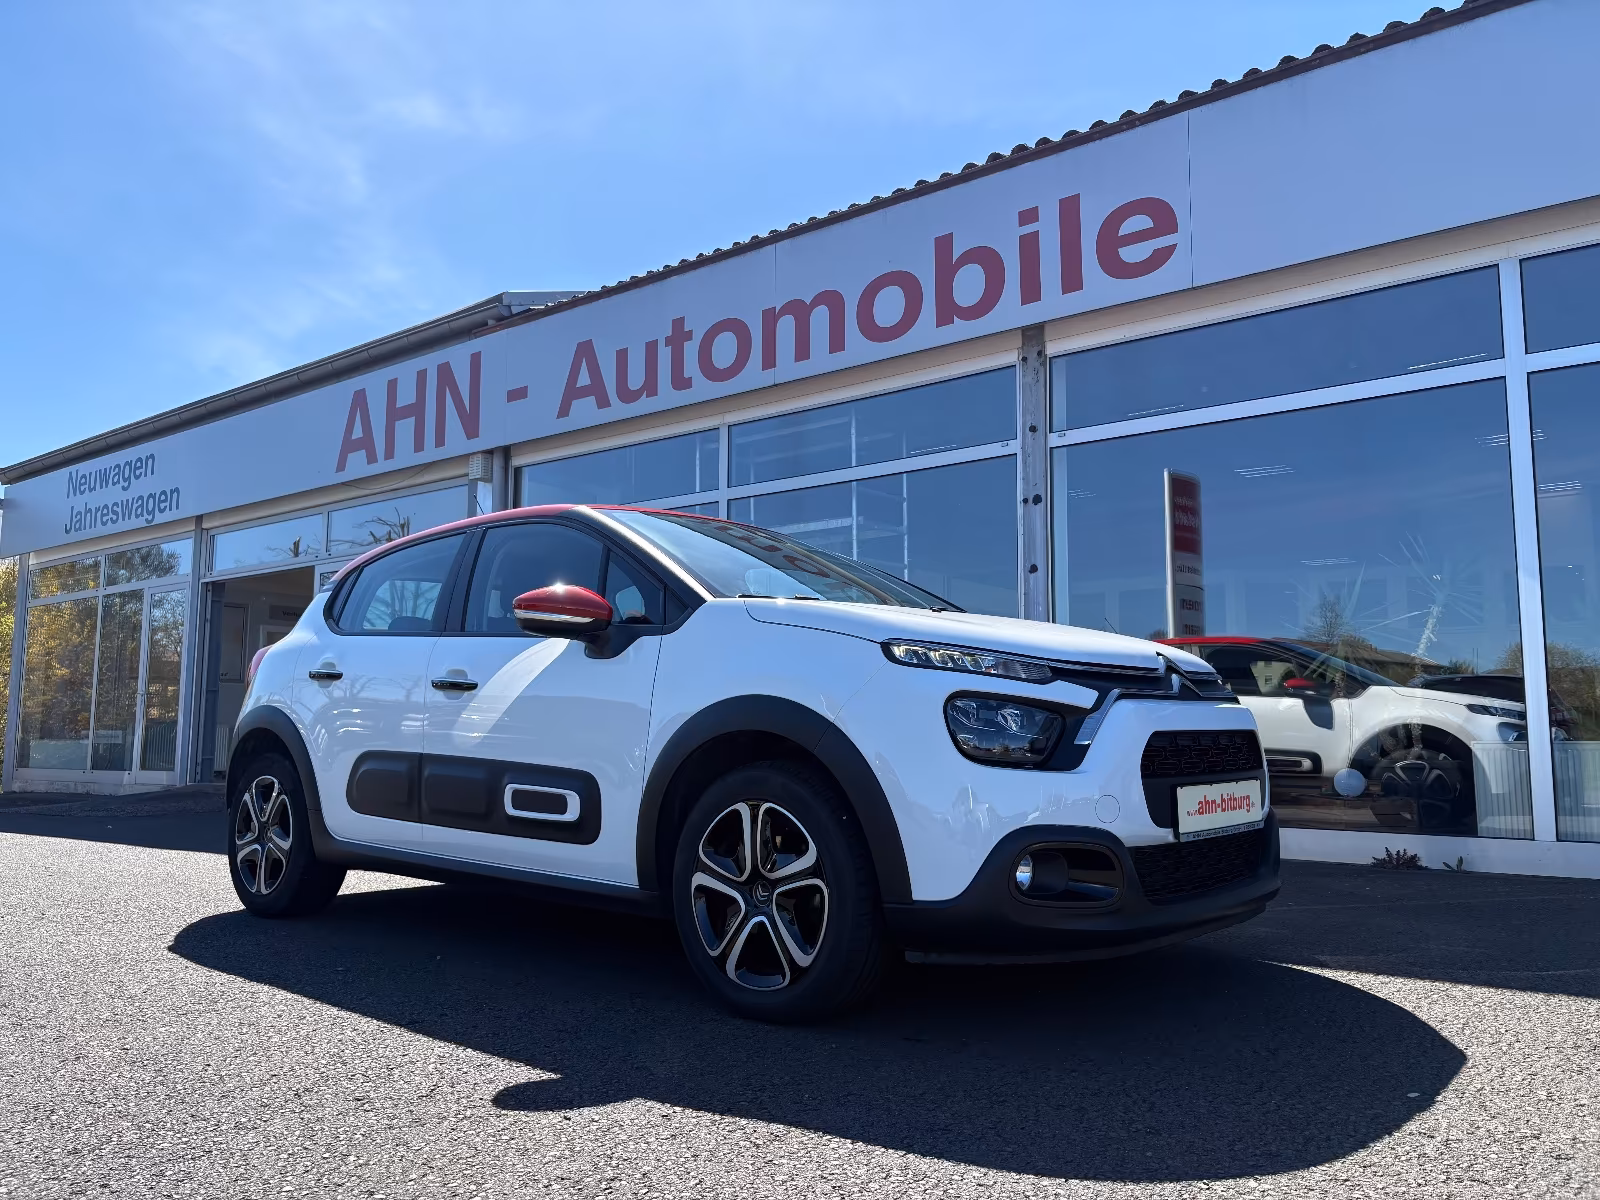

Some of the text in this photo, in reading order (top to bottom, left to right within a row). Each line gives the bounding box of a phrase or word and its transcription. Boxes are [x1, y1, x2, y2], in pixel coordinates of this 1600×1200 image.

[335, 193, 1179, 473] AHN - Automobile
[66, 453, 156, 499] Neuwagen
[64, 486, 181, 535] Jahreswagen
